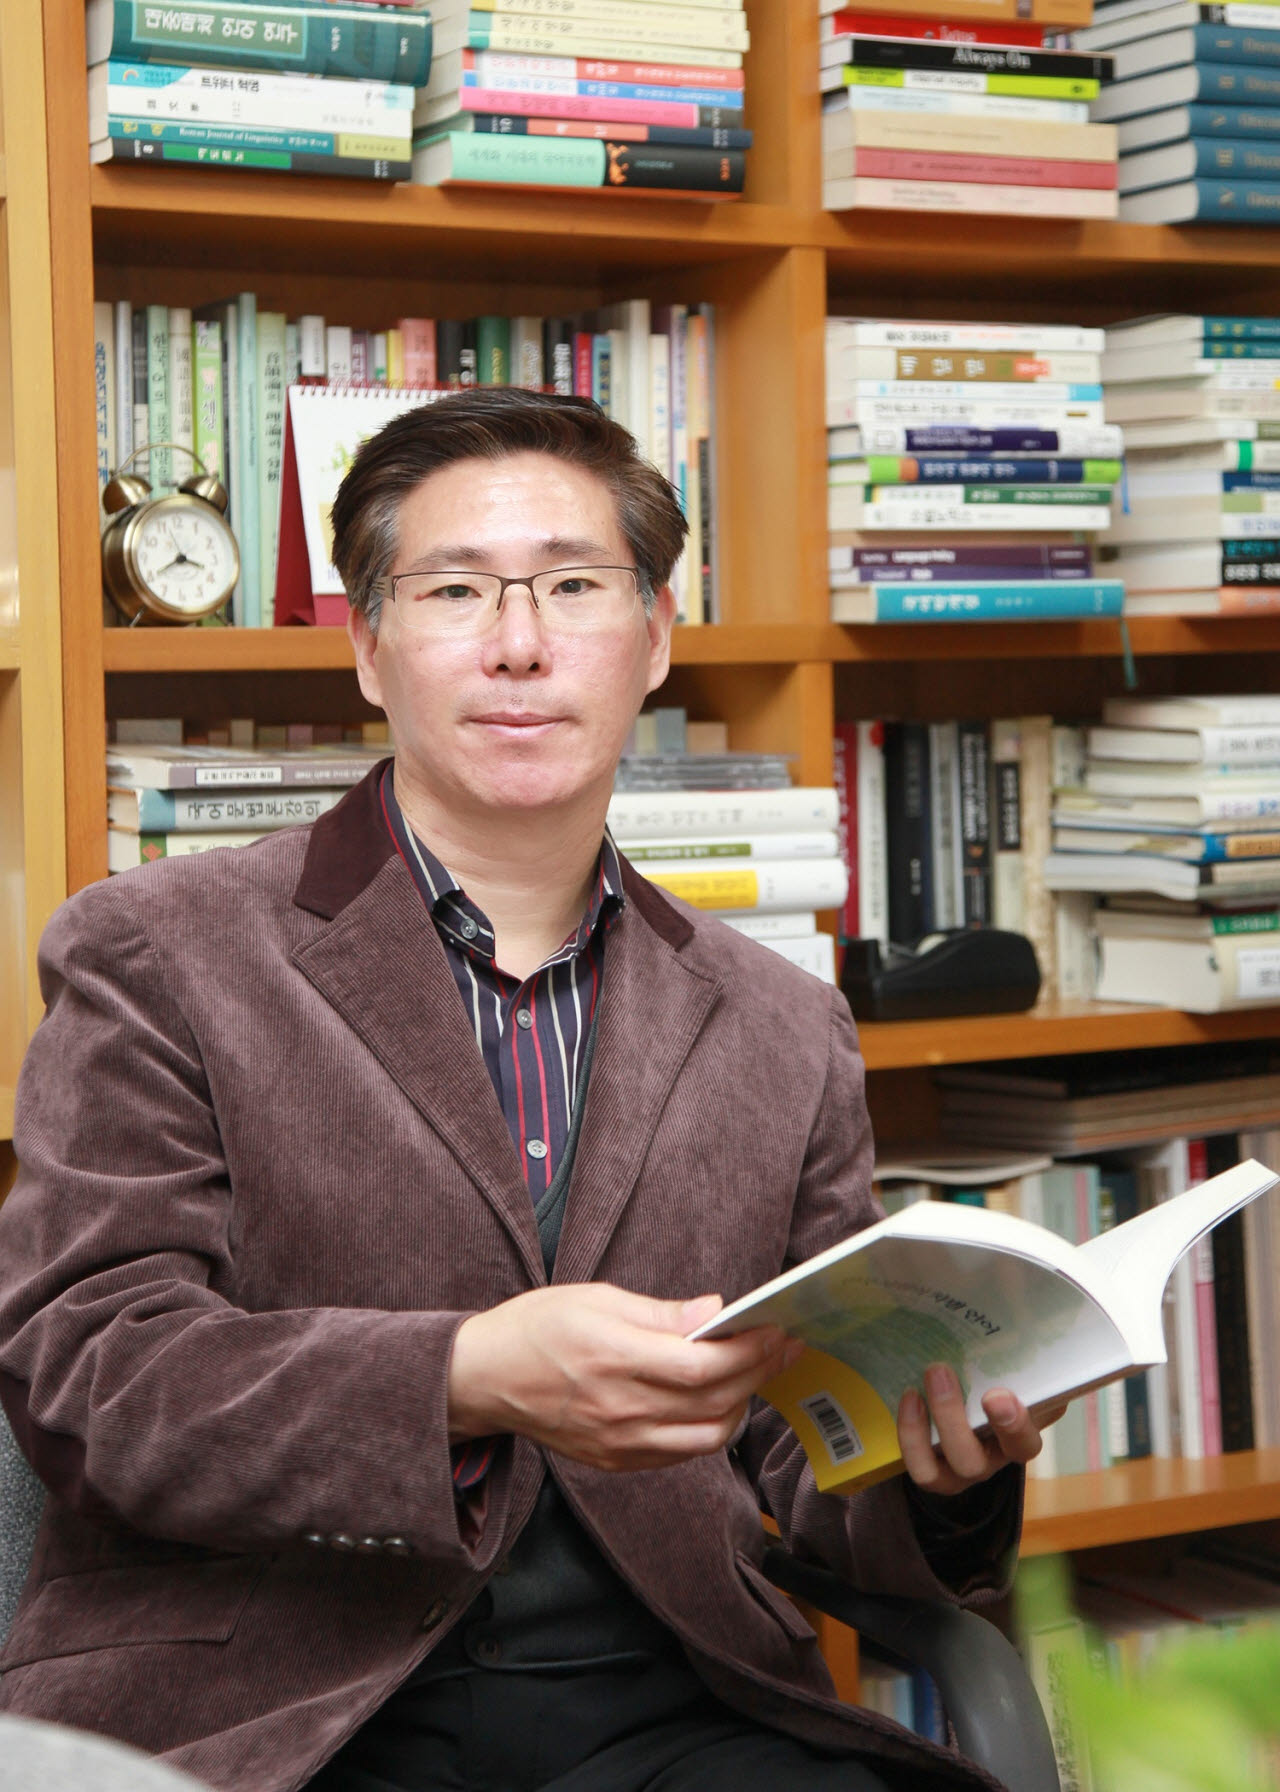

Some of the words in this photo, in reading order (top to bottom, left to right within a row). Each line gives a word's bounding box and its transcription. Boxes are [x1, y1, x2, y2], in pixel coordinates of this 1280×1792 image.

[144, 7, 214, 35] 대중매체
[221, 17, 257, 39] 언어
[263, 21, 299, 45] 연구
[953, 47, 1003, 72] Always
[1006, 50, 1031, 68] On
[201, 76, 234, 91] 트위터
[206, 129, 235, 142] Journal
[235, 131, 244, 141] of
[244, 132, 285, 146] Linguistics
[157, 520, 167, 534] 11
[172, 513, 184, 528] 12
[143, 535, 158, 548] 10
[206, 536, 215, 550] 2
[206, 571, 216, 584] 4
[188, 800, 321, 821] 국어문법론강의
